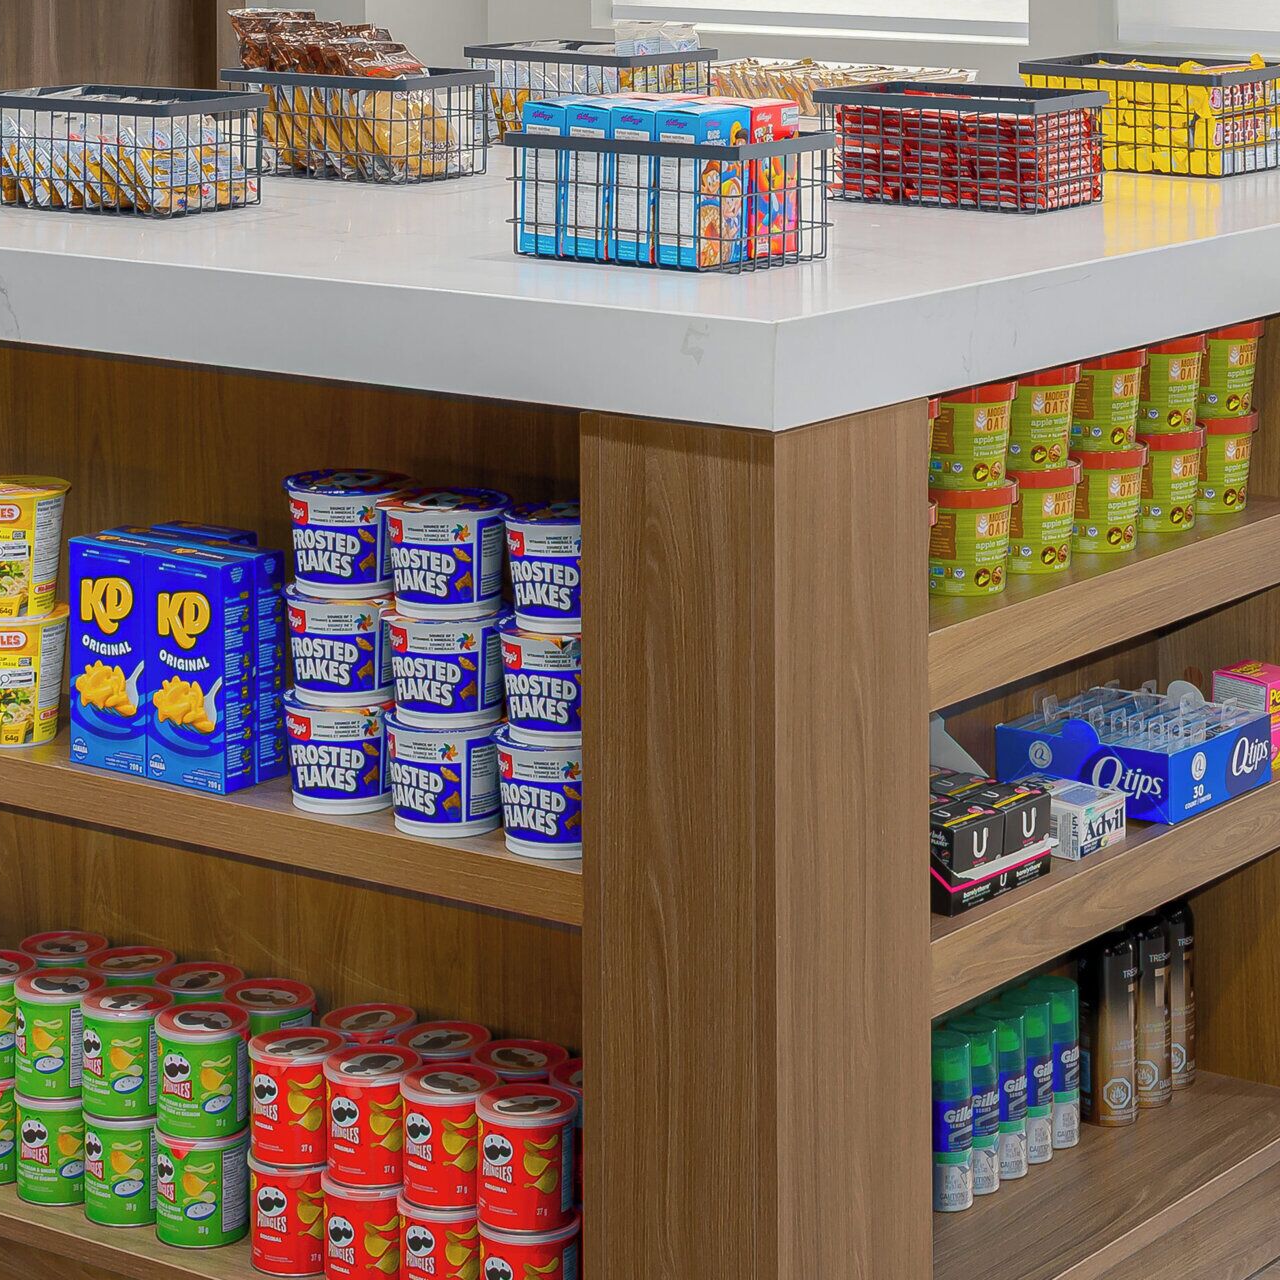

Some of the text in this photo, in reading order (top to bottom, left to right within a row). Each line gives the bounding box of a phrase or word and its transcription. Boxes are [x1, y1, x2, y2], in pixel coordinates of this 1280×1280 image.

[1044, 401, 1068, 414] OATS
[293, 529, 361, 555] FROSTED
[297, 549, 353, 577] FLAKES
[391, 547, 456, 574] FROSTED
[394, 568, 448, 598] FLAKES
[510, 560, 580, 587] FROSTED
[80, 577, 134, 635] KD
[514, 582, 572, 611] FLAKES
[0, 606, 13, 615] 64g
[157, 591, 211, 650] KD
[81, 634, 132, 656] ORIGINAL
[291, 637, 359, 663] FROSTED
[159, 649, 210, 672] ORIGINAL
[295, 658, 351, 686] FLAKES
[392, 656, 462, 684] FROSTED
[396, 678, 454, 707] FLAKES
[504, 673, 577, 701] FROSTED
[510, 695, 569, 725] FLAKES
[5, 734, 19, 743] 64g
[291, 744, 365, 770] FROSTED
[1231, 736, 1269, 777] Q-tips
[297, 766, 358, 792] FLAKES
[1092, 756, 1163, 799] Q-tips
[500, 782, 566, 812] FROSTED
[1193, 784, 1204, 799] 30
[504, 806, 558, 837] FLAKES
[1022, 807, 1037, 838] U
[1083, 806, 1124, 842] Advil
[973, 827, 989, 858] U
[1000, 872, 1008, 887] U
[163, 1077, 191, 1098] PRINGLES
[972, 1091, 1000, 1108] Gille
[253, 1104, 278, 1121] PRINGLES
[943, 1105, 973, 1123] Gille
[255, 1120, 274, 1130] ORIGINAL
[331, 1127, 360, 1145] PRINGLES
[334, 1144, 355, 1153] ORIGINAL
[405, 1143, 433, 1162] PRINGLES
[408, 1160, 428, 1171] ORIGINAL
[482, 1165, 513, 1184] PRINGLES
[484, 1182, 508, 1194] ORIGINAL
[257, 1215, 287, 1233] PRINGLES
[259, 1232, 282, 1242] ORIGINAL
[328, 1246, 355, 1265] PRINGLES
[406, 1257, 435, 1274] PRINGLES
[330, 1263, 350, 1274] ORIGINAL
